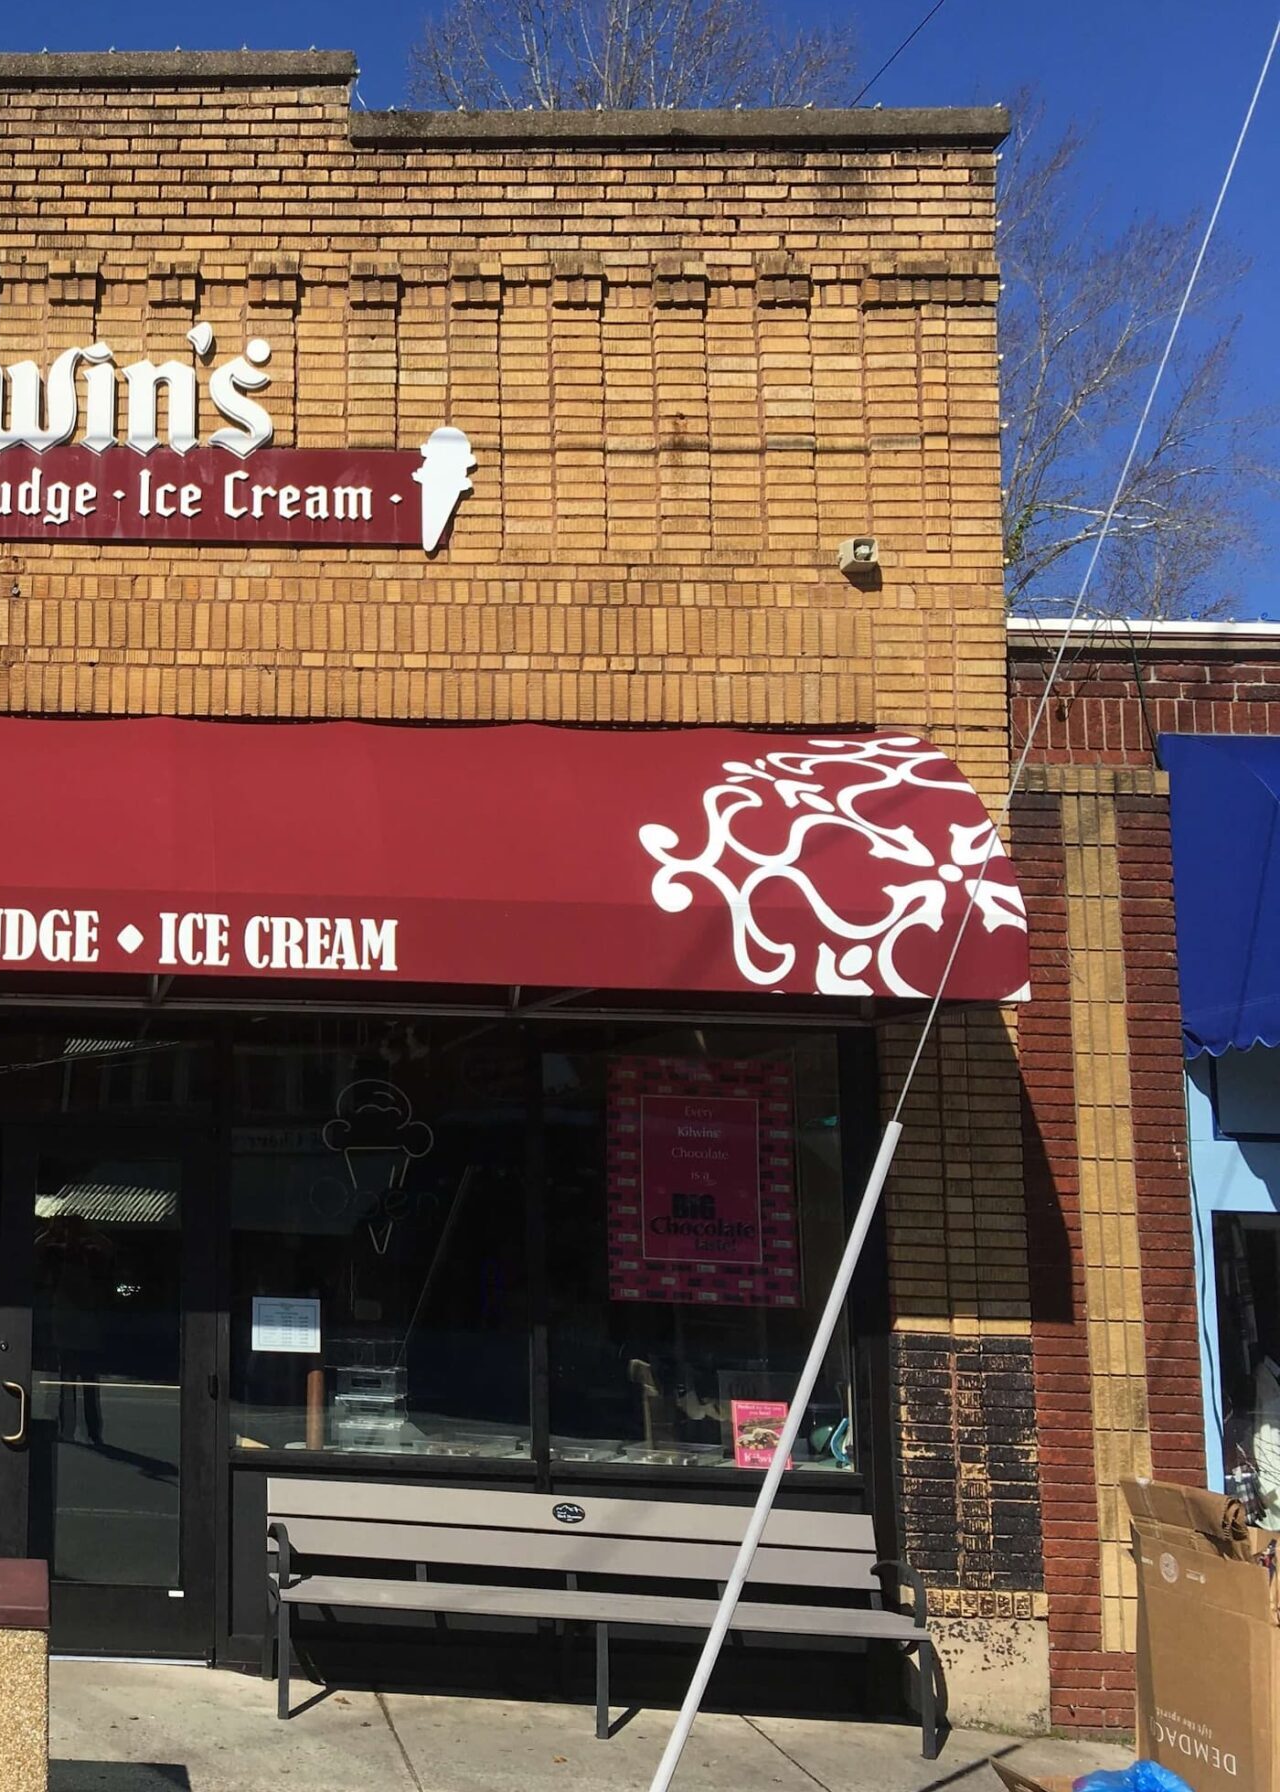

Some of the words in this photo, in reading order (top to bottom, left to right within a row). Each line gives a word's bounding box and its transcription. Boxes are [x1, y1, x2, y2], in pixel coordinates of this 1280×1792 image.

[138, 467, 203, 518] Ice
[222, 469, 374, 521] Cream
[157, 912, 230, 967] ICE
[244, 915, 399, 973] CREAM
[677, 1126, 721, 1139] Kilwins
[671, 1147, 729, 1161] Chocolate
[649, 1216, 756, 1238] Chocolate
